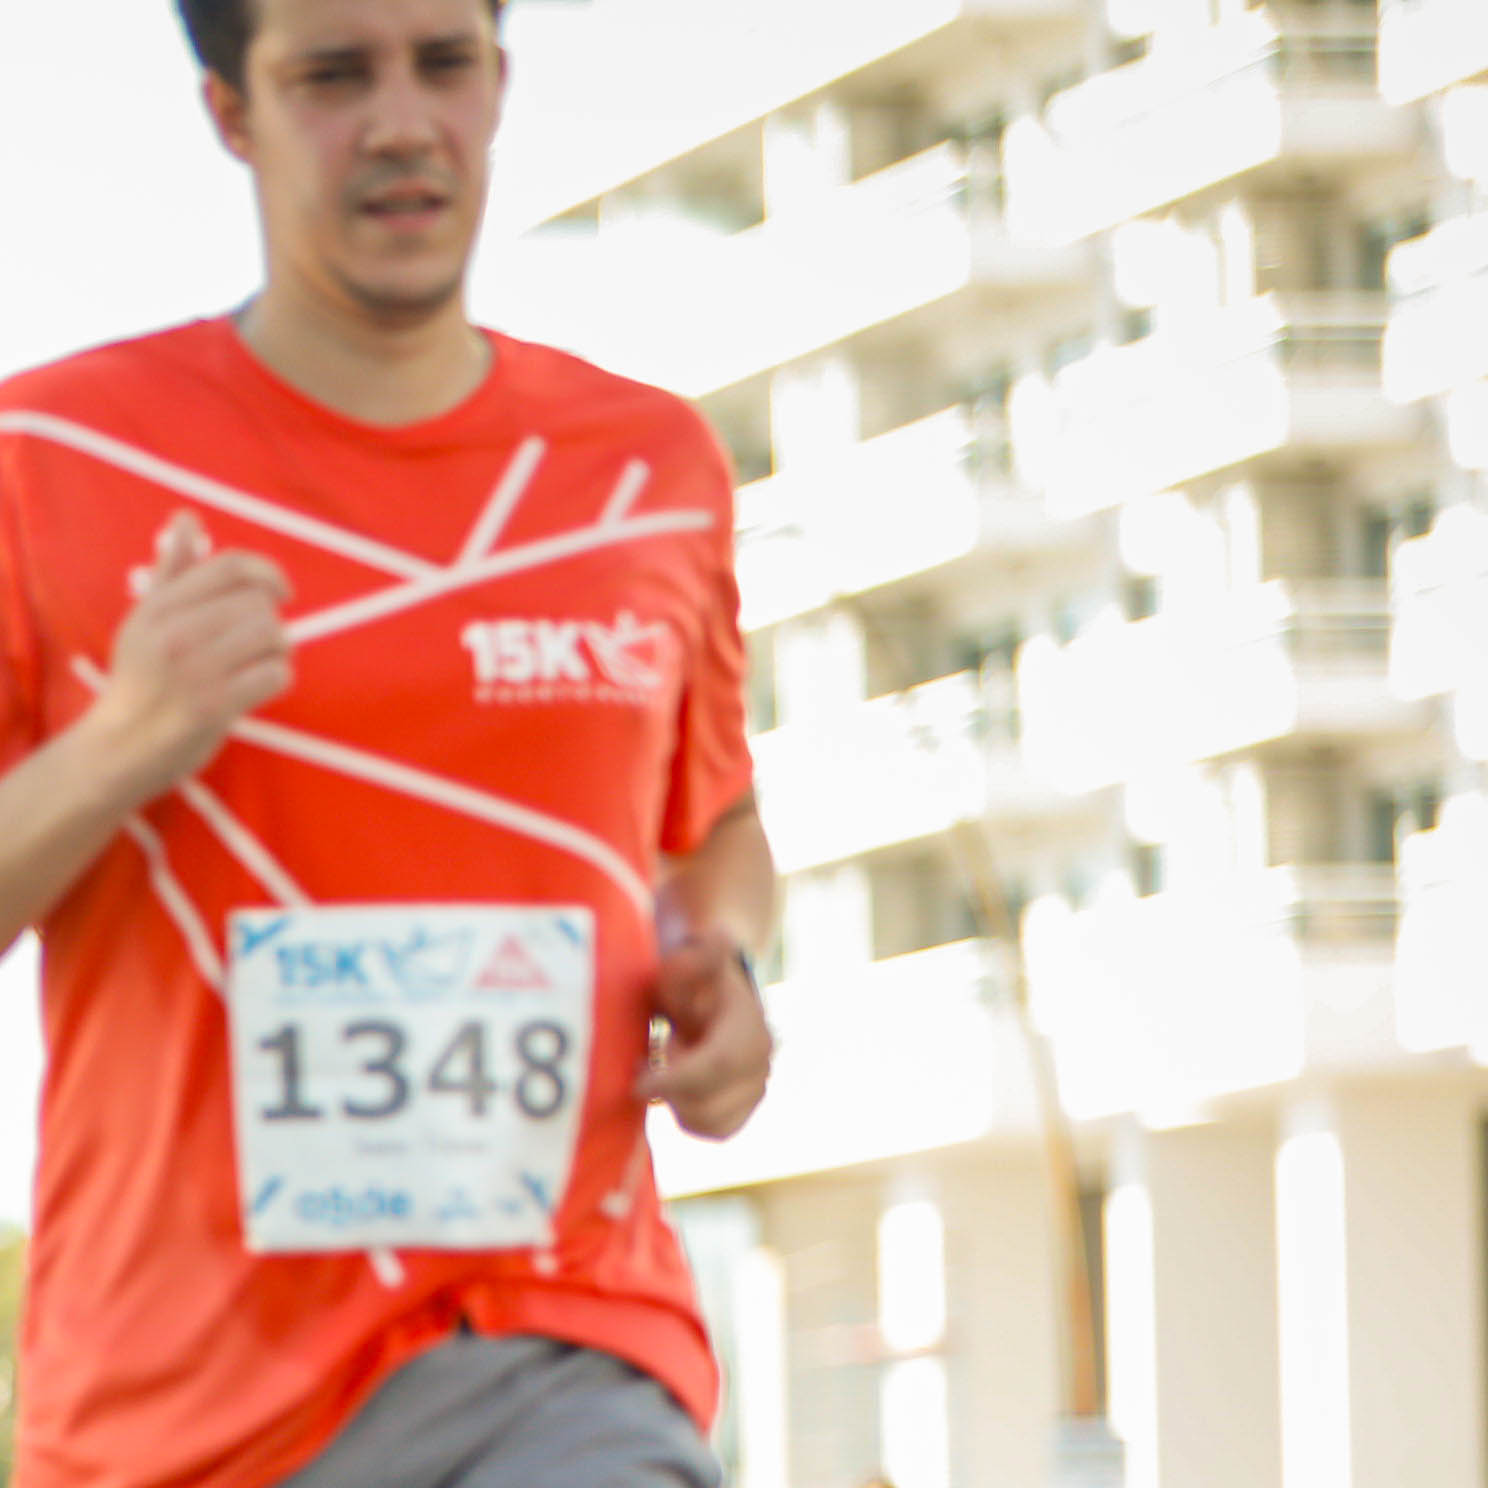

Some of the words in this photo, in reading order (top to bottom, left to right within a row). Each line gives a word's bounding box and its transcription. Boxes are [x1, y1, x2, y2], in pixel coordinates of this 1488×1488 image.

[460, 618, 590, 685] 15K
[276, 941, 368, 988] 15K
[256, 1016, 573, 1123] 1348
